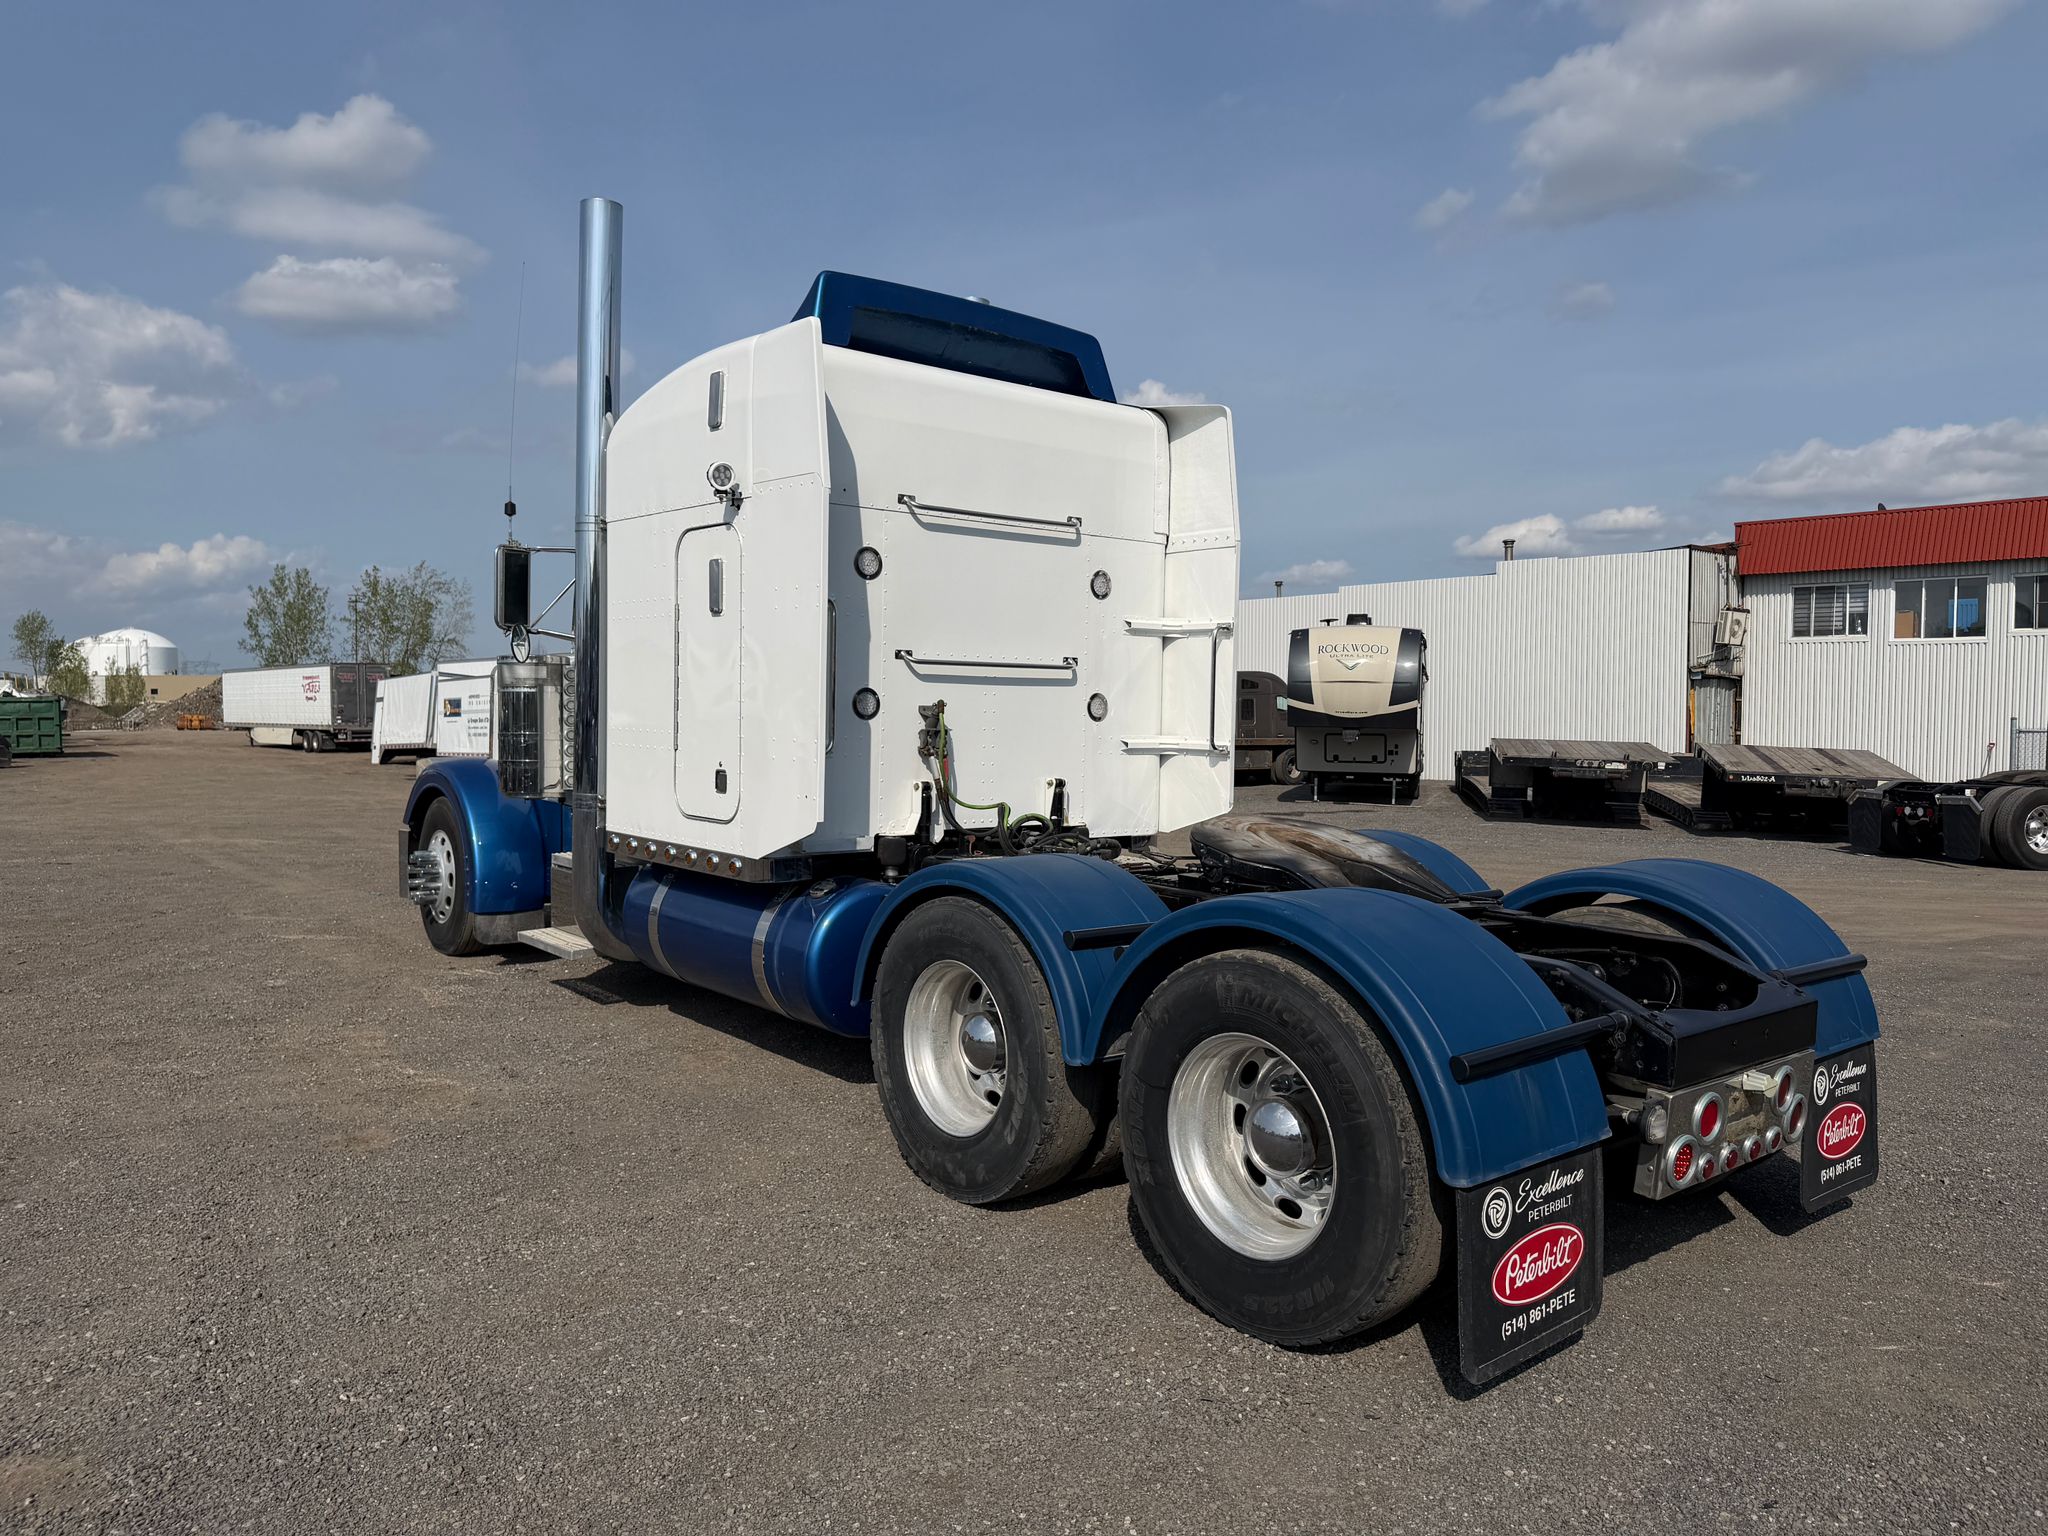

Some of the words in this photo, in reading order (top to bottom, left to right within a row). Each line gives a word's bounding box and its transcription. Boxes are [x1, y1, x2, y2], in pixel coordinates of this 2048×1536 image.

[1318, 643, 1389, 655] ROCKWOOD
[1830, 1061, 1867, 1089] Excellence
[1835, 1081, 1861, 1098] PETERBILT
[1823, 1113, 1862, 1151] Peterbilt
[1821, 1165, 1835, 1184] (514)
[1836, 1154, 1862, 1174] 861-PETE
[1515, 1168, 1584, 1213] Excellence
[1528, 1194, 1573, 1223] PETERBILT
[1505, 1234, 1578, 1297] Peterbilt
[1502, 1313, 1527, 1341] (514)
[1529, 1289, 1576, 1324] 861-PETE
